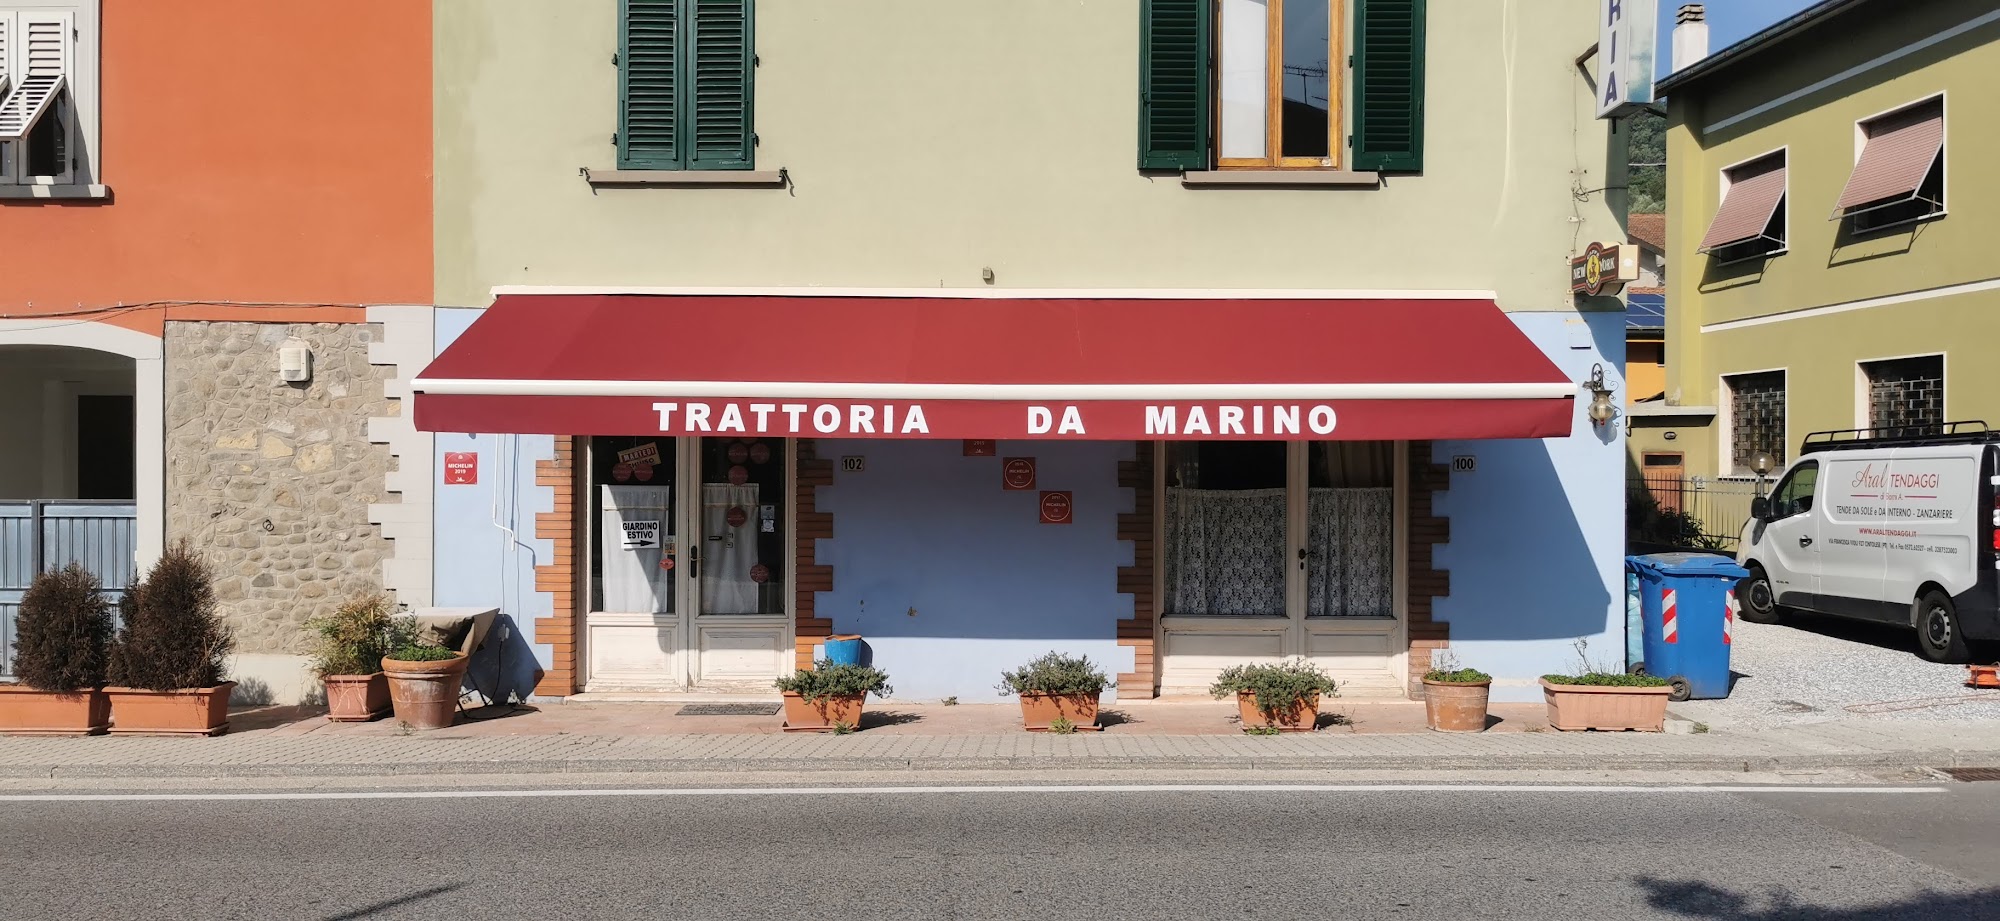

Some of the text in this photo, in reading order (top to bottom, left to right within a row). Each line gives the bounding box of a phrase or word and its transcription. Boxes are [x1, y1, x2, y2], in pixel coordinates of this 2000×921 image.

[1573, 257, 1615, 280] NEW YORK
[652, 402, 1337, 435] TRATTORIA DA MARINO
[843, 458, 862, 470] 102
[1455, 458, 1474, 470] 100
[1852, 463, 1939, 488] Aral TENDAGGI
[1836, 505, 1852, 514] TENDE
[1852, 506, 1860, 515] DA
[1860, 506, 1873, 516] SOLE
[1879, 507, 1886, 516] DA
[1887, 508, 1912, 517] INTERNO
[1916, 509, 1953, 519] ZANZARIERE
[622, 522, 658, 531] GIARDINO
[1859, 528, 1916, 537] WWW.ARALTENDAGGI.IT
[627, 531, 654, 539] ESTIVO
